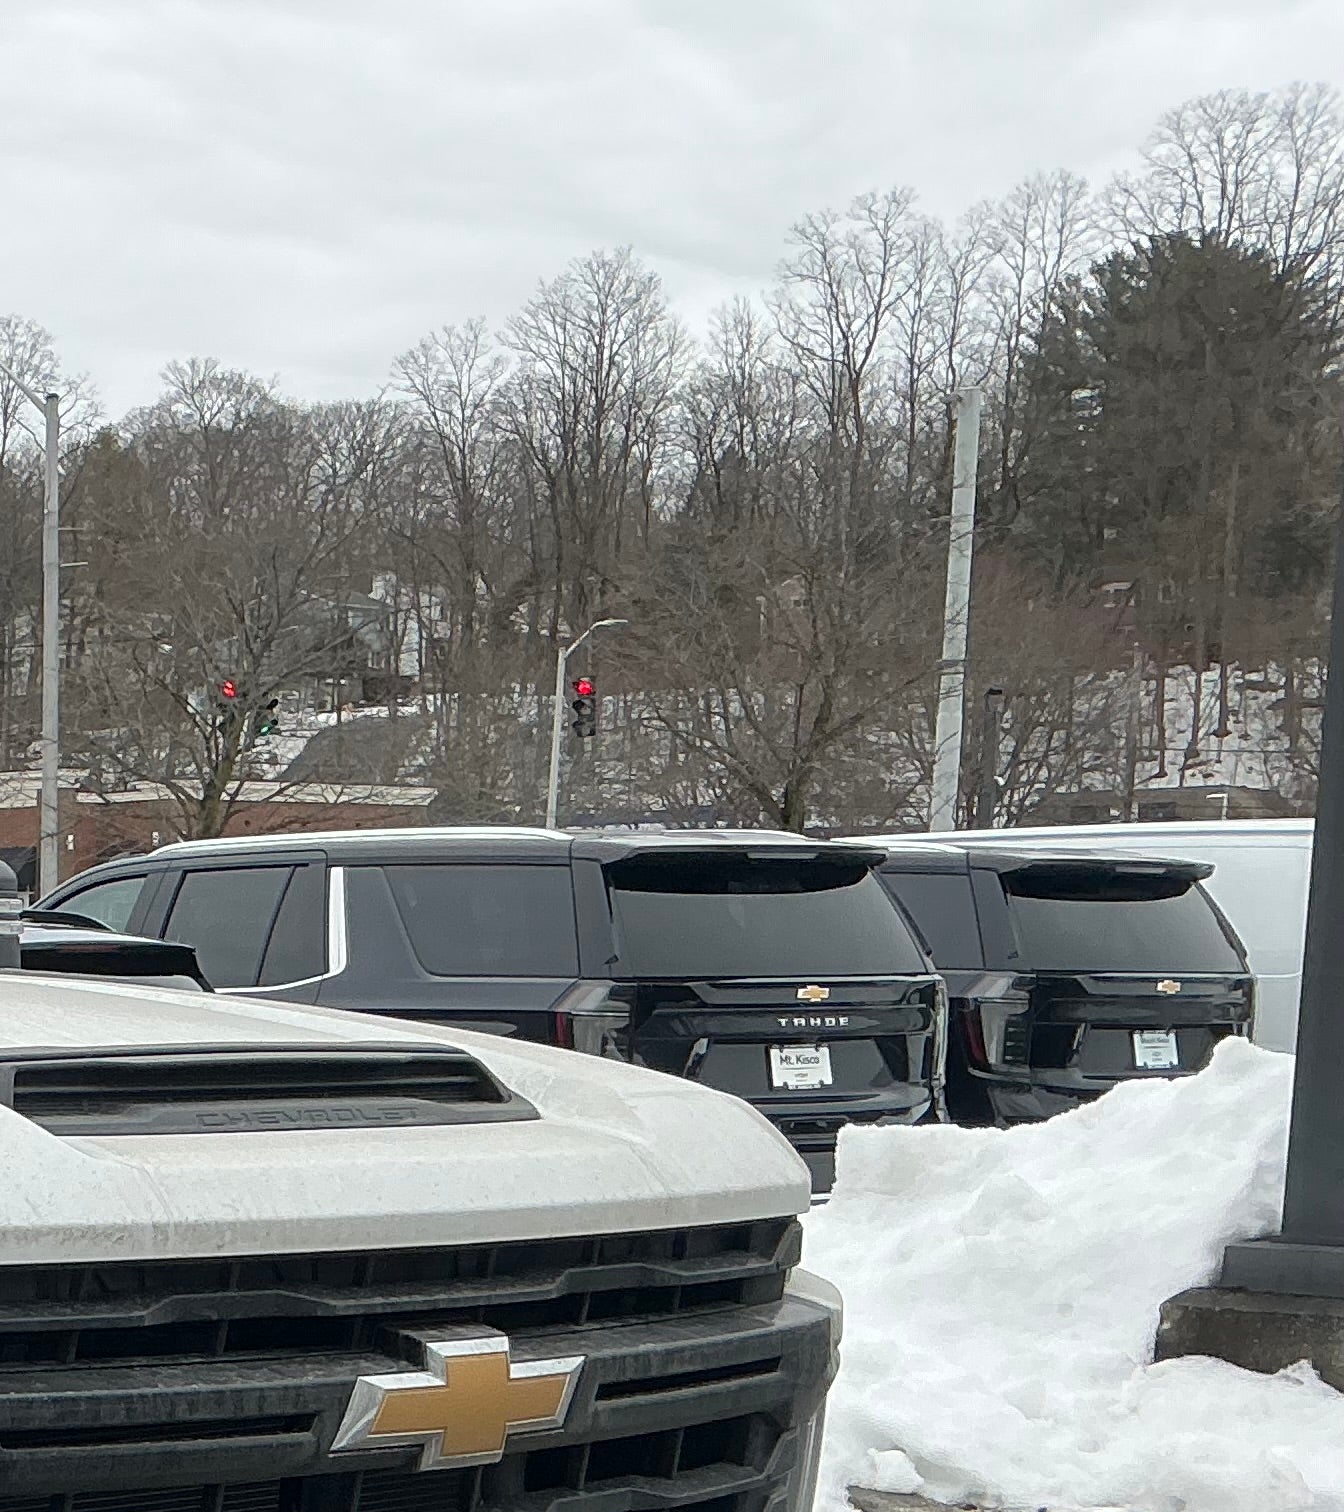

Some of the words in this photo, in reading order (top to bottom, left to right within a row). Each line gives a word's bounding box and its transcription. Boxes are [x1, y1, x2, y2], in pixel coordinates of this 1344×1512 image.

[777, 1017, 849, 1027] TAHOE
[796, 1054, 820, 1065] Kisco
[195, 1107, 418, 1127] CHEVROLET
